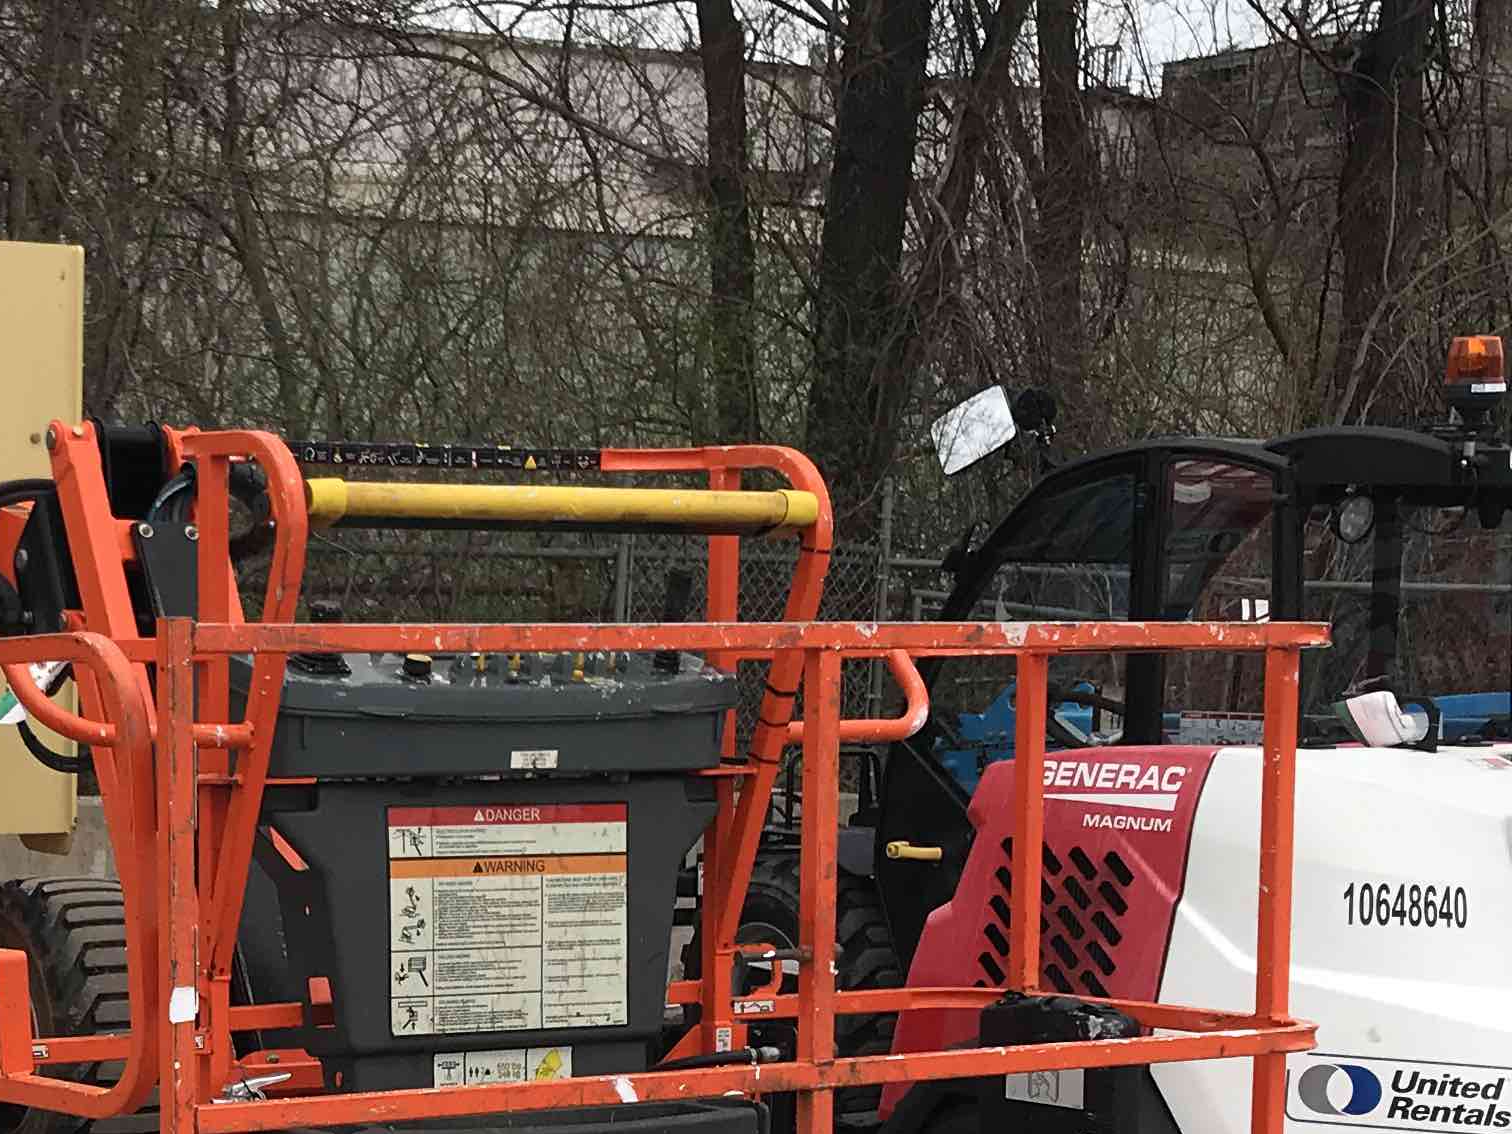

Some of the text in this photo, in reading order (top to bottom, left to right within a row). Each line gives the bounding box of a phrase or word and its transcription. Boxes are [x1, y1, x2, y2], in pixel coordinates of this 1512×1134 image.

[486, 808, 540, 822] DANGER
[1082, 814, 1172, 832] MAGNUM
[484, 860, 545, 874] WARNING
[1343, 882, 1467, 928] 10648640
[1391, 1070, 1506, 1101] United
[1387, 1096, 1511, 1128] Rentals
